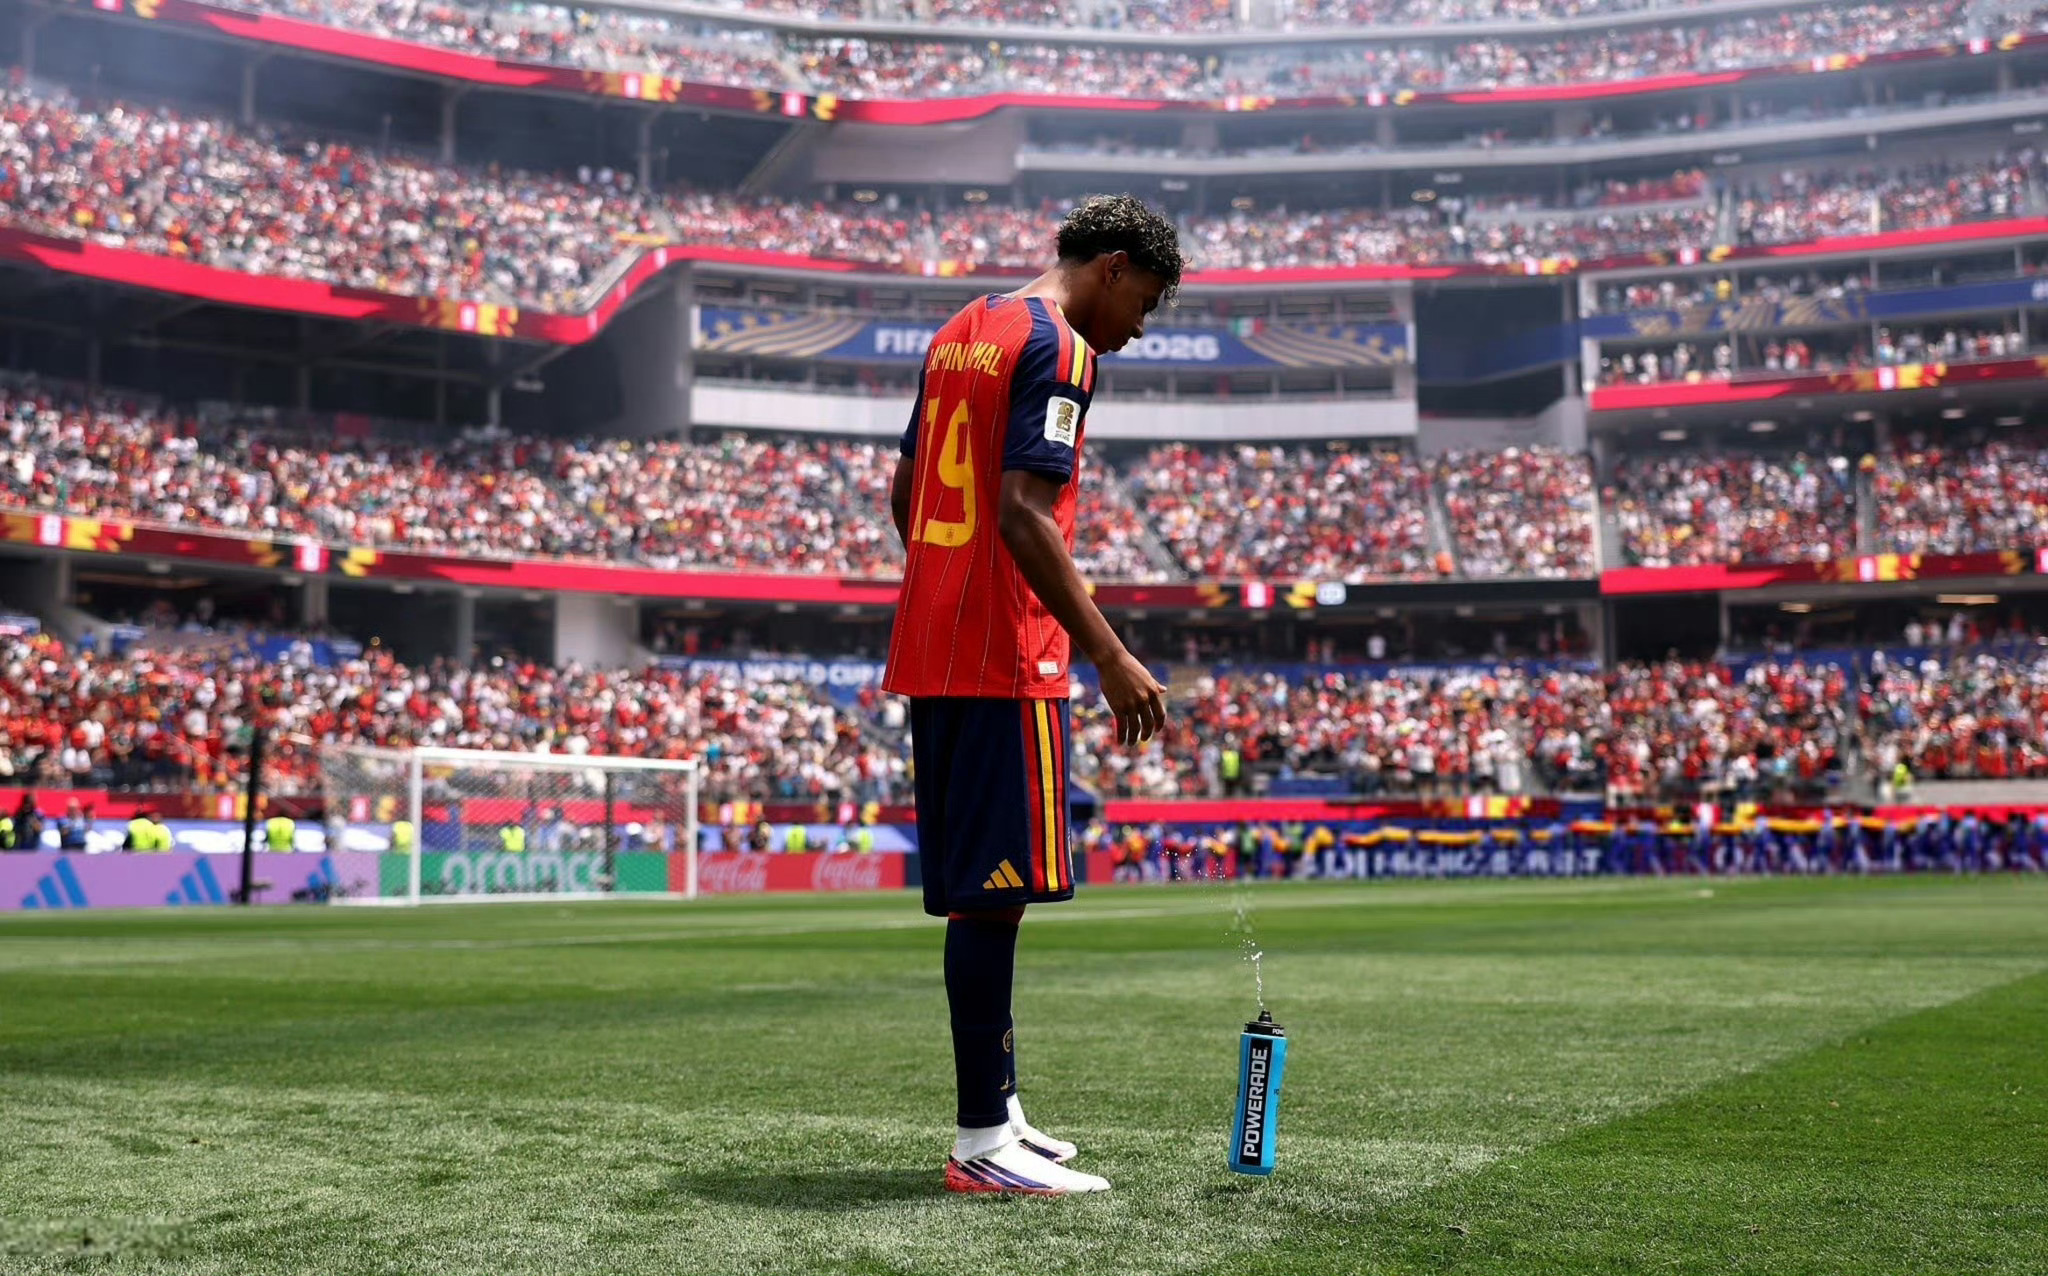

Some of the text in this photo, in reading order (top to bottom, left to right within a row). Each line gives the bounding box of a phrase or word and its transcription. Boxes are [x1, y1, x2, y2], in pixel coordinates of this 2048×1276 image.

[876, 328, 1219, 360] FIFA 2026
[912, 397, 977, 547] 19
[1243, 1048, 1267, 1157] POWERADE
